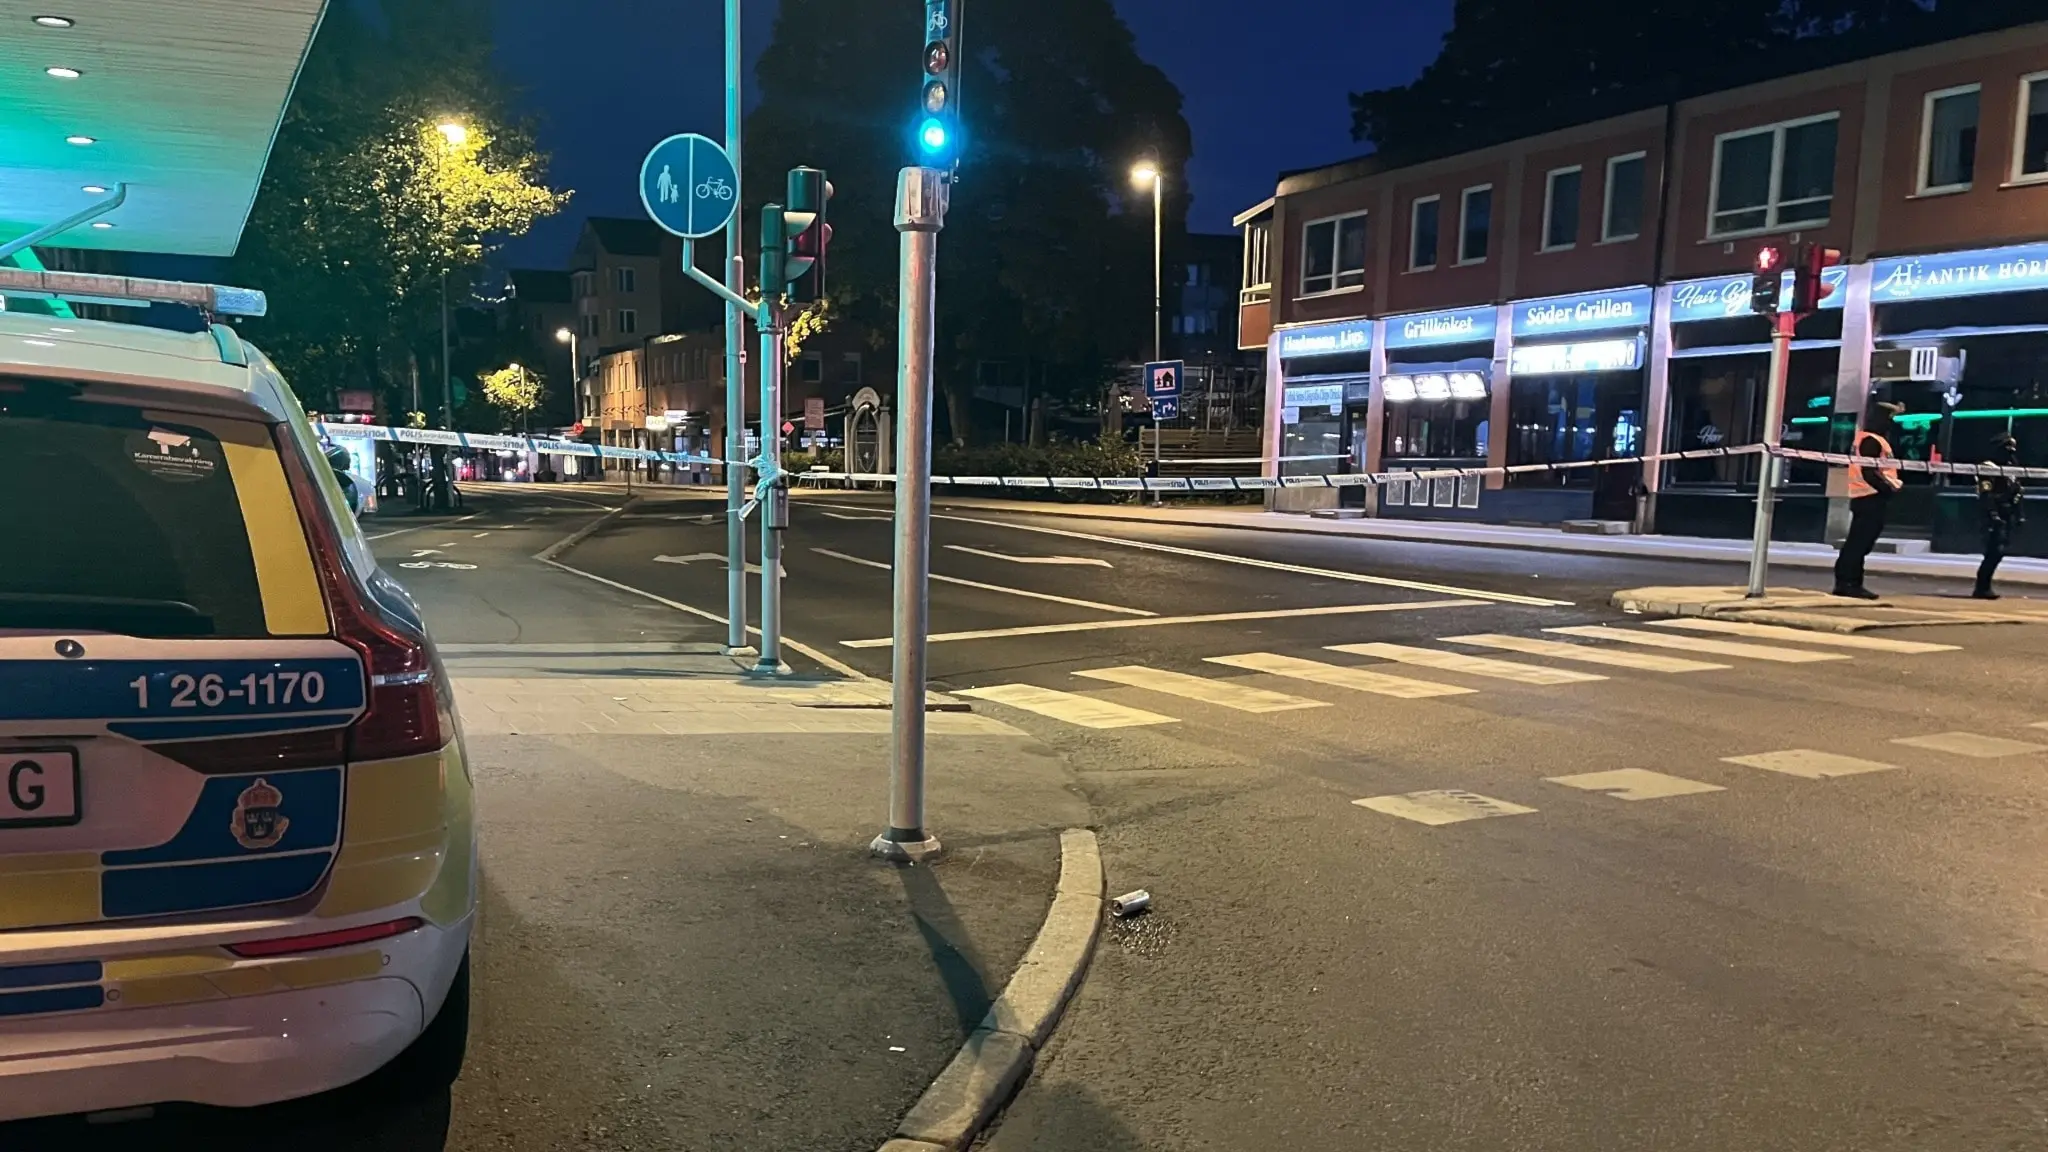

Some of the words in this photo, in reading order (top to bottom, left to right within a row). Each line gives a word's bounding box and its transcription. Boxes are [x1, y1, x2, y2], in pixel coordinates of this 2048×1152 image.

[1926, 264, 1990, 285] ANTIK
[1997, 258, 2048, 280] HÖR
[1672, 284, 1718, 309] Hair
[1526, 306, 1574, 326] Söder
[1575, 298, 1633, 322] Grillen
[1404, 315, 1474, 340] Grillköket
[364, 429, 386, 438] POLIS
[400, 430, 422, 439] POLIS
[502, 441, 524, 449] POLIS
[538, 441, 559, 450] POLIS
[130, 675, 148, 709] 1
[170, 671, 325, 708] 26-1170
[8, 760, 45, 811] G
